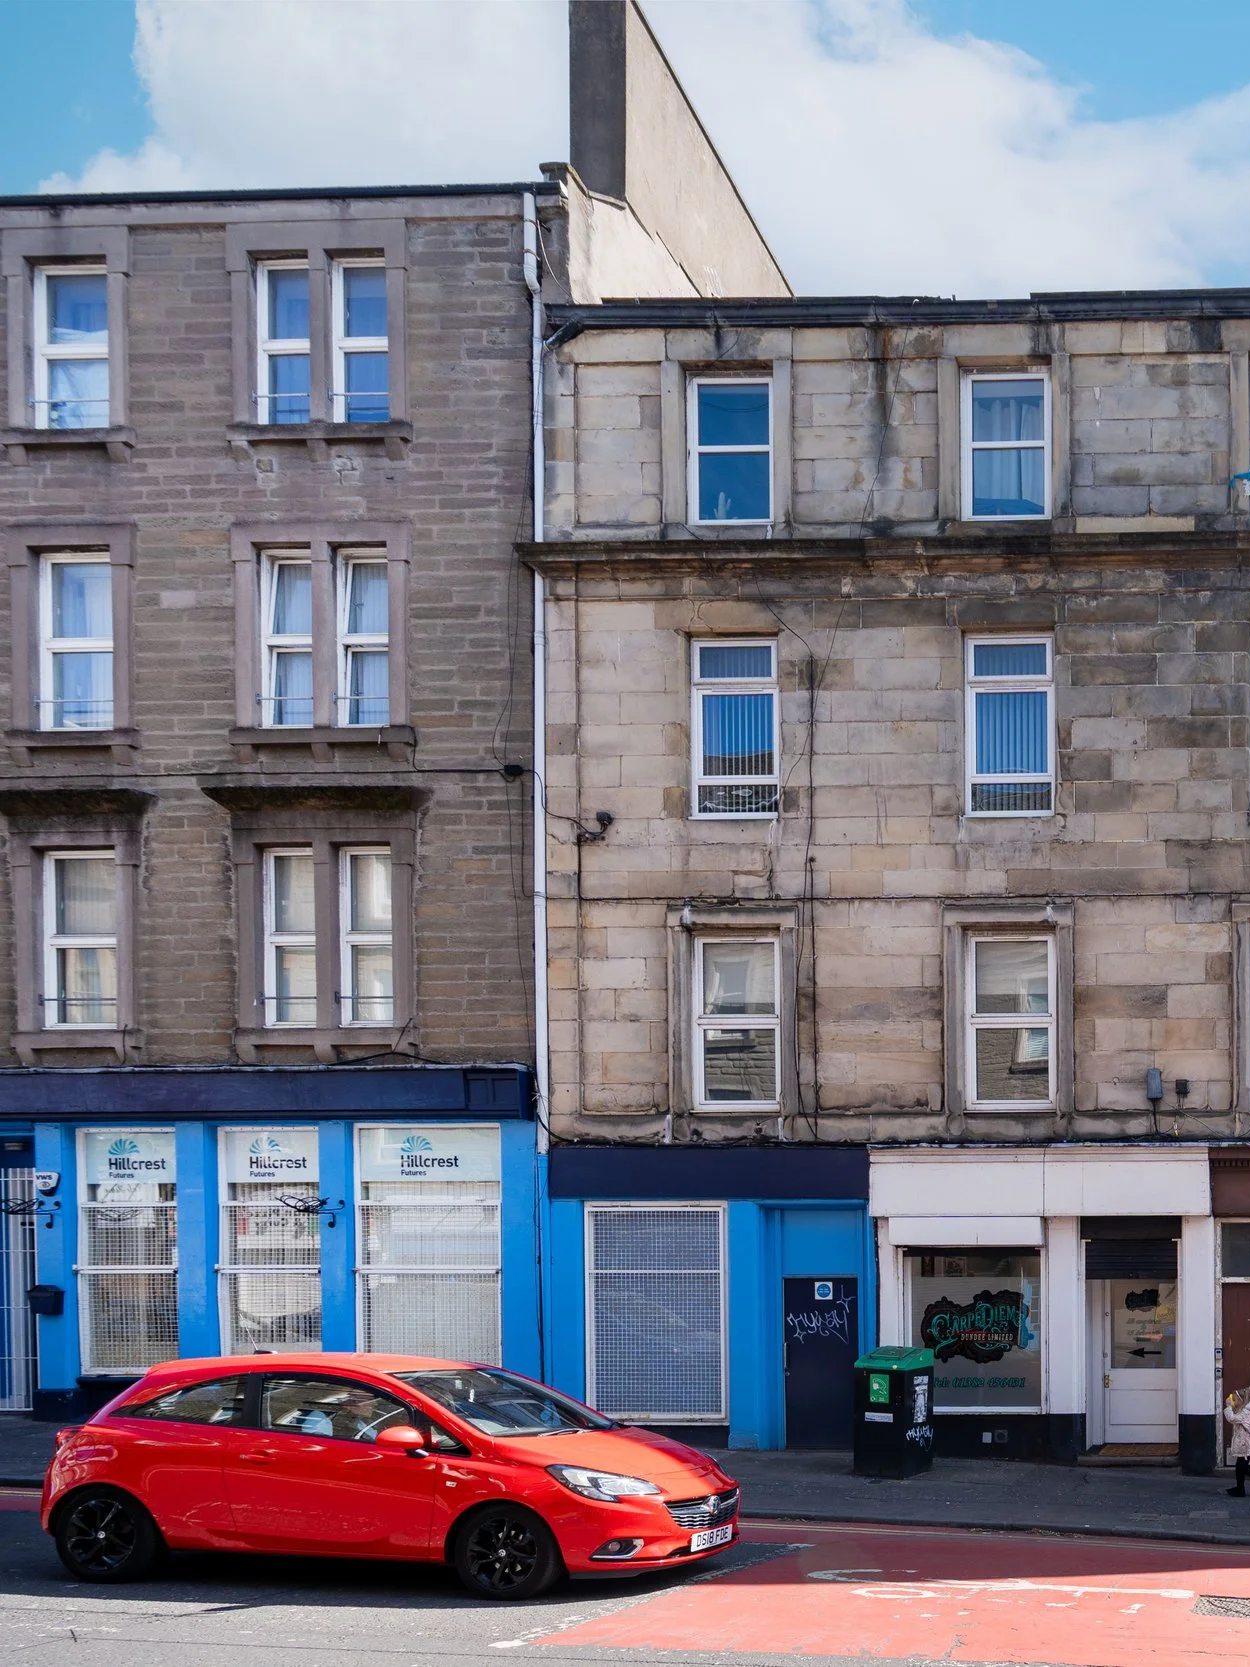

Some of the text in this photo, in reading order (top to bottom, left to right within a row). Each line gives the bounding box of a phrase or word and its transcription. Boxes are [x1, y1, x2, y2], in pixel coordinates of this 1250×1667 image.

[108, 1157, 166, 1170] Hillcrest
[249, 1156, 307, 1169] Hillcrest
[400, 1155, 459, 1168] Hillcrest
[960, 1333, 1014, 1341] DUNDEE LIMITED
[696, 1526, 729, 1547] DS18 FDE
